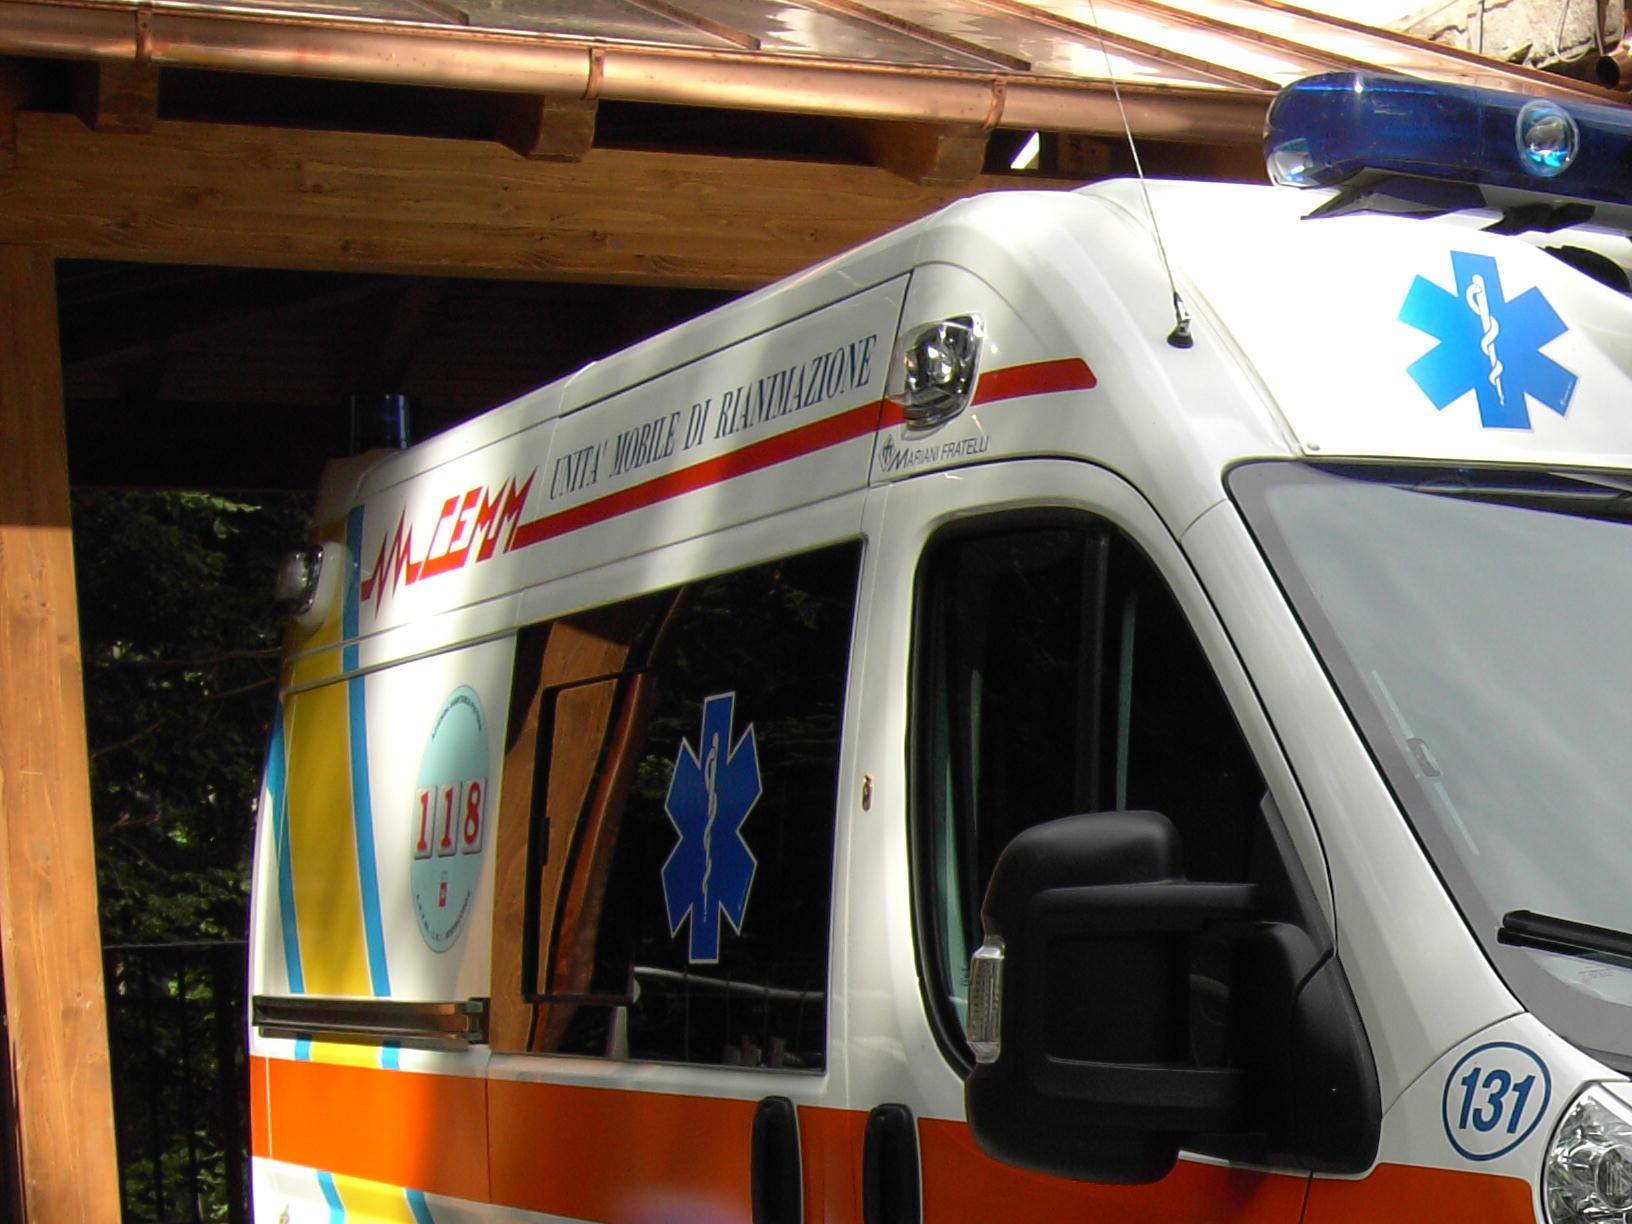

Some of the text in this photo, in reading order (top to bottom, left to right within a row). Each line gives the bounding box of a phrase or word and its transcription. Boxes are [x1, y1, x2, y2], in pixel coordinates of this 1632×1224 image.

[608, 411, 681, 478] MOBILE
[684, 399, 712, 451] DI
[713, 334, 878, 439] RIANIMAZIONE
[940, 434, 990, 460] FRATELLI
[416, 781, 482, 853] 118
[1458, 1066, 1536, 1135] 131
